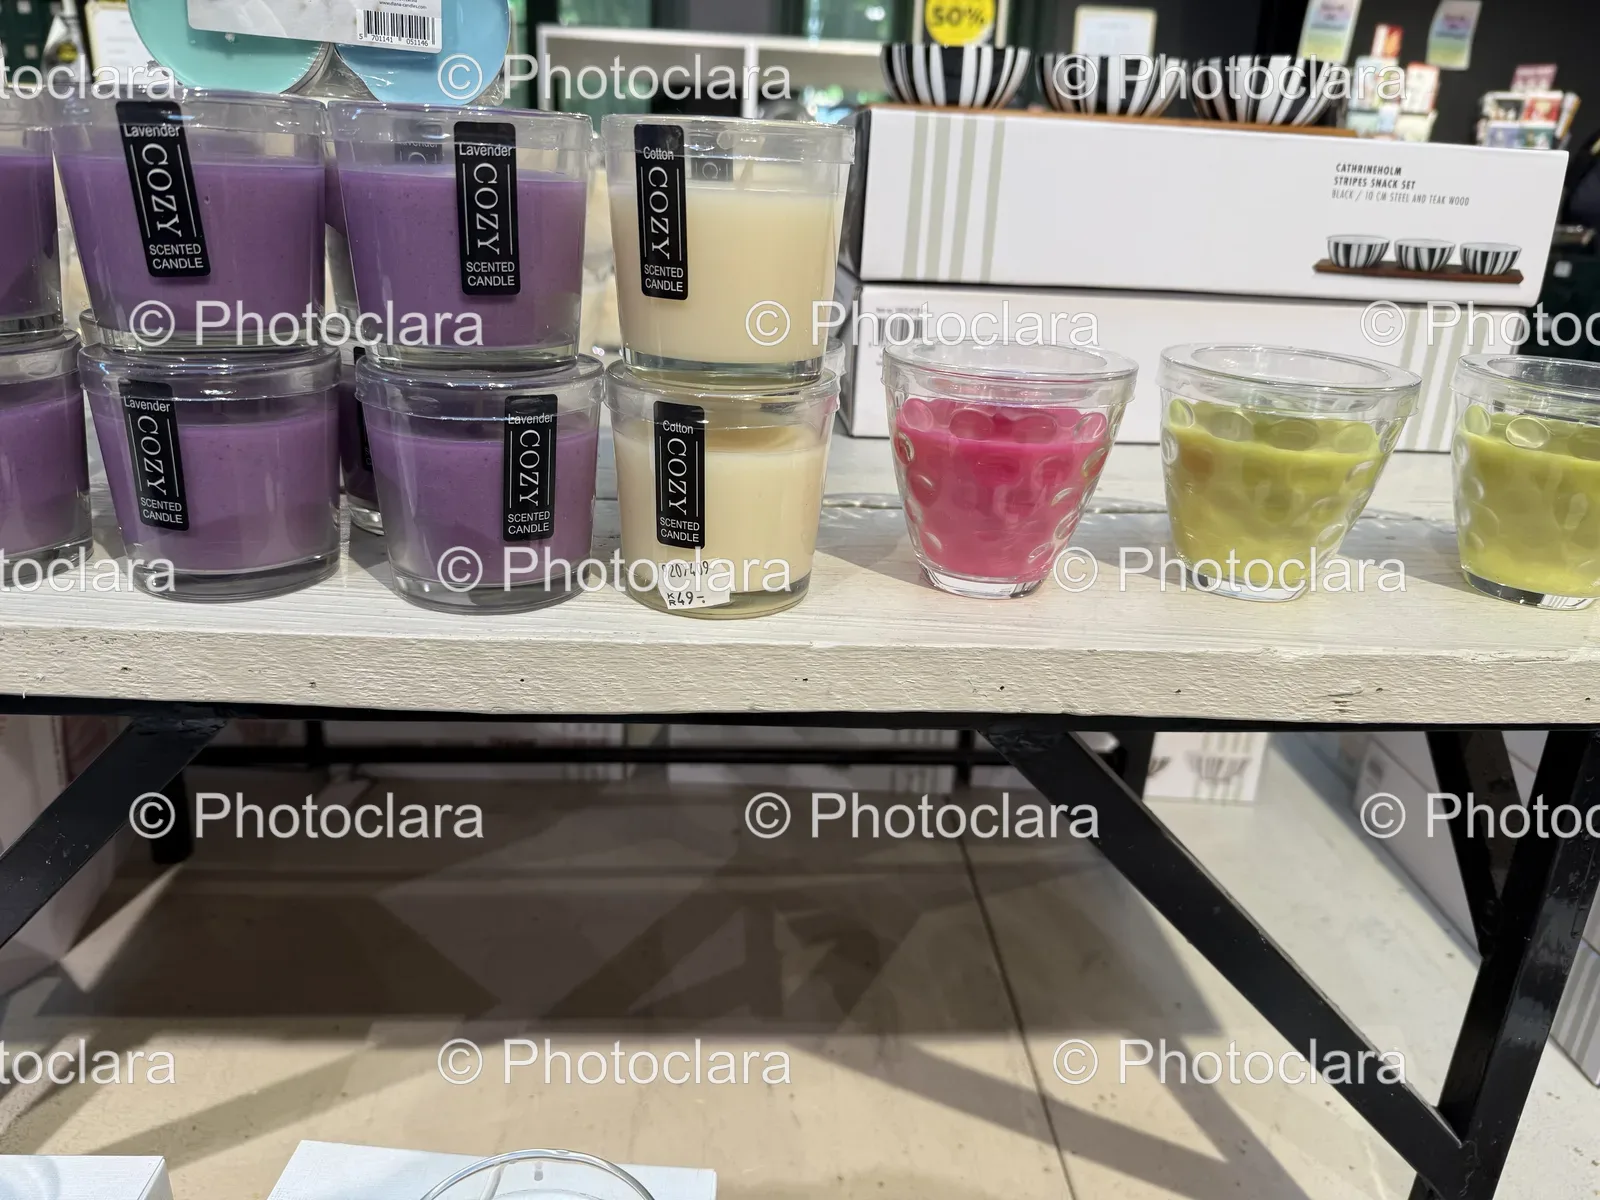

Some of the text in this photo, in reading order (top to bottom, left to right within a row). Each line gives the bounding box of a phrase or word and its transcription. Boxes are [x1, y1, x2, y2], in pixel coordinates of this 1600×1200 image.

[932, 5, 985, 26] 50%
[123, 123, 180, 137] Lavender
[459, 143, 512, 157] Lavender
[643, 146, 674, 161] Cotton
[1335, 163, 1402, 176] CATHRINEHOLM
[141, 143, 182, 238] COZY
[1334, 176, 1416, 190] STRIPES SNACK SET
[1331, 188, 1354, 200] BLACK
[1365, 190, 1373, 201] 10
[1375, 191, 1387, 201] CM
[1389, 192, 1409, 203] STEEL
[1411, 193, 1426, 204] AND
[1429, 194, 1445, 205] TEAK
[1448, 195, 1470, 207] WOOD
[473, 162, 500, 255] COZY
[648, 166, 670, 260] COZY
[149, 244, 202, 256] SCENTED
[152, 257, 204, 270] CANDLE
[466, 261, 515, 273] SCENTED
[644, 264, 684, 278] SCENTED
[467, 275, 515, 287] CANDLE
[645, 277, 684, 292] CANDLE
[123, 395, 171, 412] Lavender
[508, 412, 554, 425] Lavender
[662, 420, 694, 435] Cotton
[137, 415, 167, 496] COZY
[519, 429, 541, 507] COZY
[667, 437, 687, 516] COZY
[140, 497, 182, 512] SCENTED
[142, 508, 183, 524] CANDLE
[507, 510, 550, 523] SCENTED
[508, 522, 549, 535] CANDLE
[659, 517, 700, 531] SCENTED
[660, 528, 700, 543] CANDLE
